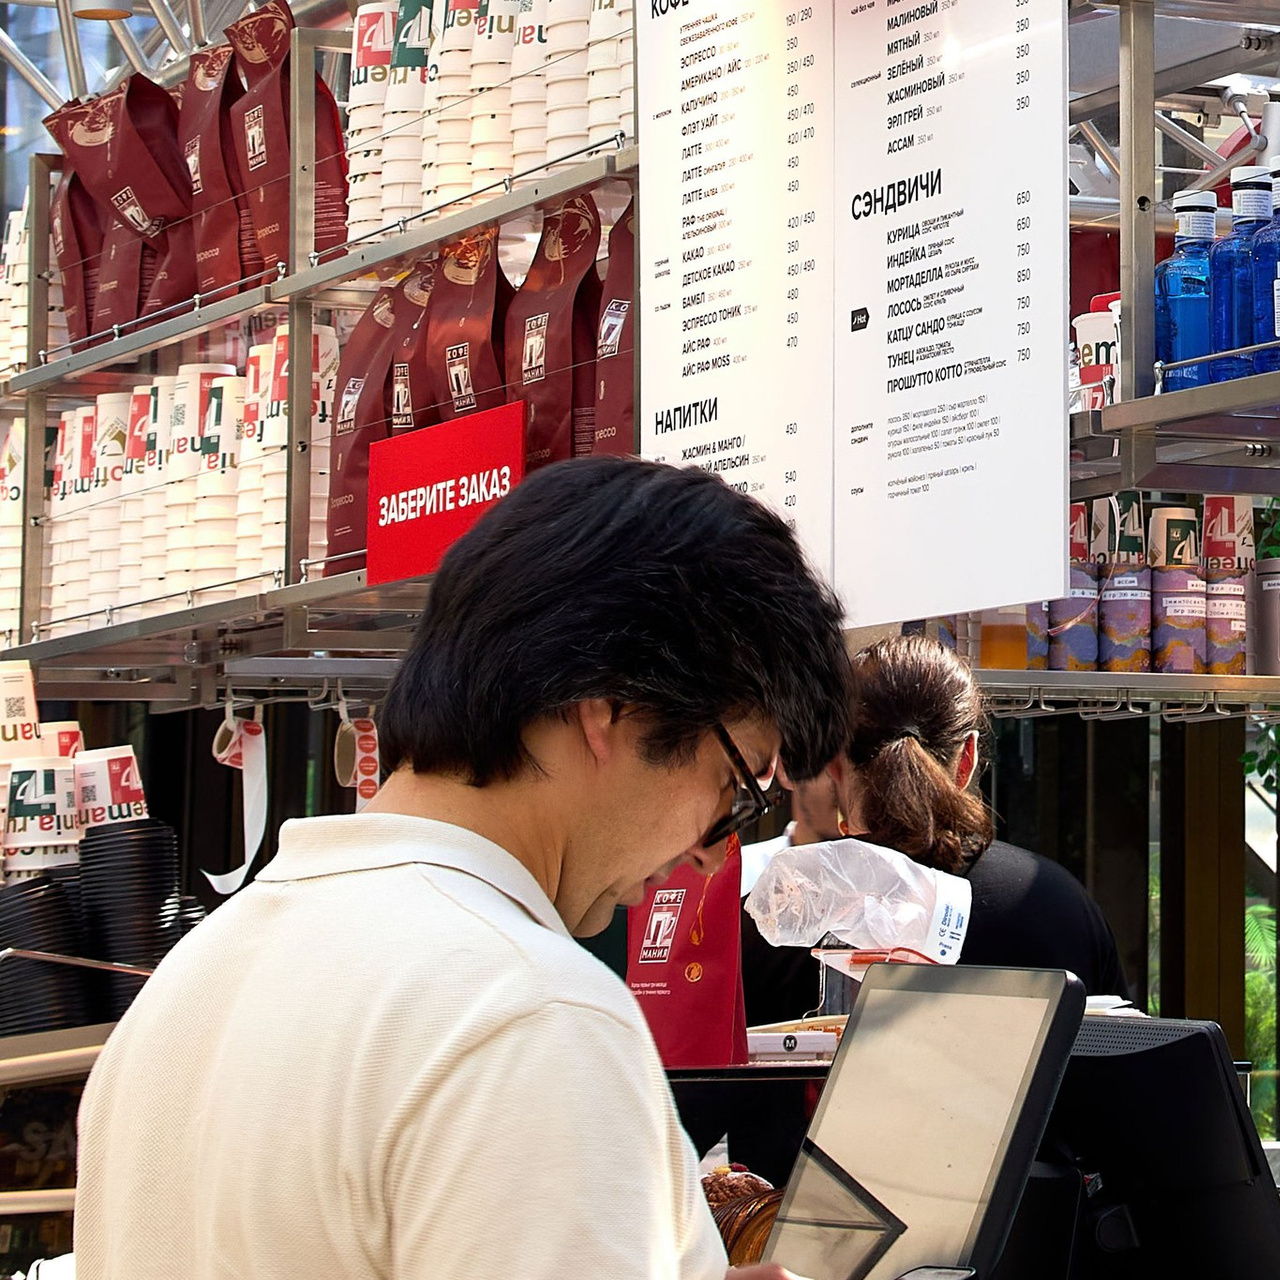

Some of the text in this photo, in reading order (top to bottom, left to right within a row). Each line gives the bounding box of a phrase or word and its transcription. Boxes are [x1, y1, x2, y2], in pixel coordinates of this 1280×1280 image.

[801, 7, 813, 22] 290
[887, 0, 939, 32] МАЛИНОВЫЙ
[1016, 17, 1030, 33] 350
[887, 30, 921, 56] МЯТНЫЙ
[1016, 43, 1030, 59] 350
[680, 45, 717, 69] ЭСПРЕССО
[803, 54, 815, 69] 450
[681, 59, 742, 92] АМЕРИКАНО АЙС
[887, 54, 924, 81] ЗЕЛЁНЫЙ
[1016, 69, 1030, 85] 350
[887, 72, 945, 106] ЖАСМИНОВЫЙ
[681, 91, 718, 115] КАПУЧИНО
[1016, 95, 1030, 111] 350
[681, 113, 719, 137] ФЛЭТ УАЙТ
[887, 104, 924, 130] ЭРЛ ГРЕЙ
[681, 142, 703, 160] ЛАТТЕ
[887, 134, 914, 156] АССАМ
[681, 165, 703, 183] ЛАТТЕ
[681, 188, 703, 206] ЛАТТЕ
[851, 168, 942, 221] СЭНДВИЧИ
[1016, 190, 1031, 205] 650
[682, 214, 696, 228] РАФ
[1016, 216, 1031, 231] 650
[887, 222, 921, 245] КУРИЦА
[682, 246, 705, 263] КАКАО
[887, 246, 927, 270] ИНДЕЙКА
[1016, 242, 1031, 258] 750
[682, 260, 735, 288] ДЕТСКОЕ КАКАО
[887, 266, 944, 294] МОРТАДЕЛЛА
[1016, 268, 1031, 283] 850
[682, 291, 706, 310] БАМБЛ
[887, 297, 922, 319] ЛОСОСЬ
[1017, 295, 1031, 311] 750
[682, 304, 742, 332] ЭСПРЕССО ТОНИК
[887, 317, 945, 345] КАТЦУ САНДО
[1017, 321, 1031, 337] 750
[682, 337, 711, 355] АЙС РАФ
[1017, 347, 1031, 363] 750
[682, 354, 731, 378] АЙС РАФ MOSS
[887, 349, 915, 369] ТУНЕЦ
[887, 369, 934, 394] ПРОШУТТО
[935, 363, 963, 382] КОТТО
[655, 397, 718, 435] НАПИТКИ
[681, 444, 712, 461] ЖАСМИН
[717, 435, 742, 453] МАНГО
[713, 454, 750, 474] АПЕЛЬСИН
[378, 465, 511, 527] ЗАБЕРИТЕ ЗАКАЗ
[656, 892, 683, 904] КОФЕ
[641, 948, 668, 959] МАНИЯ
